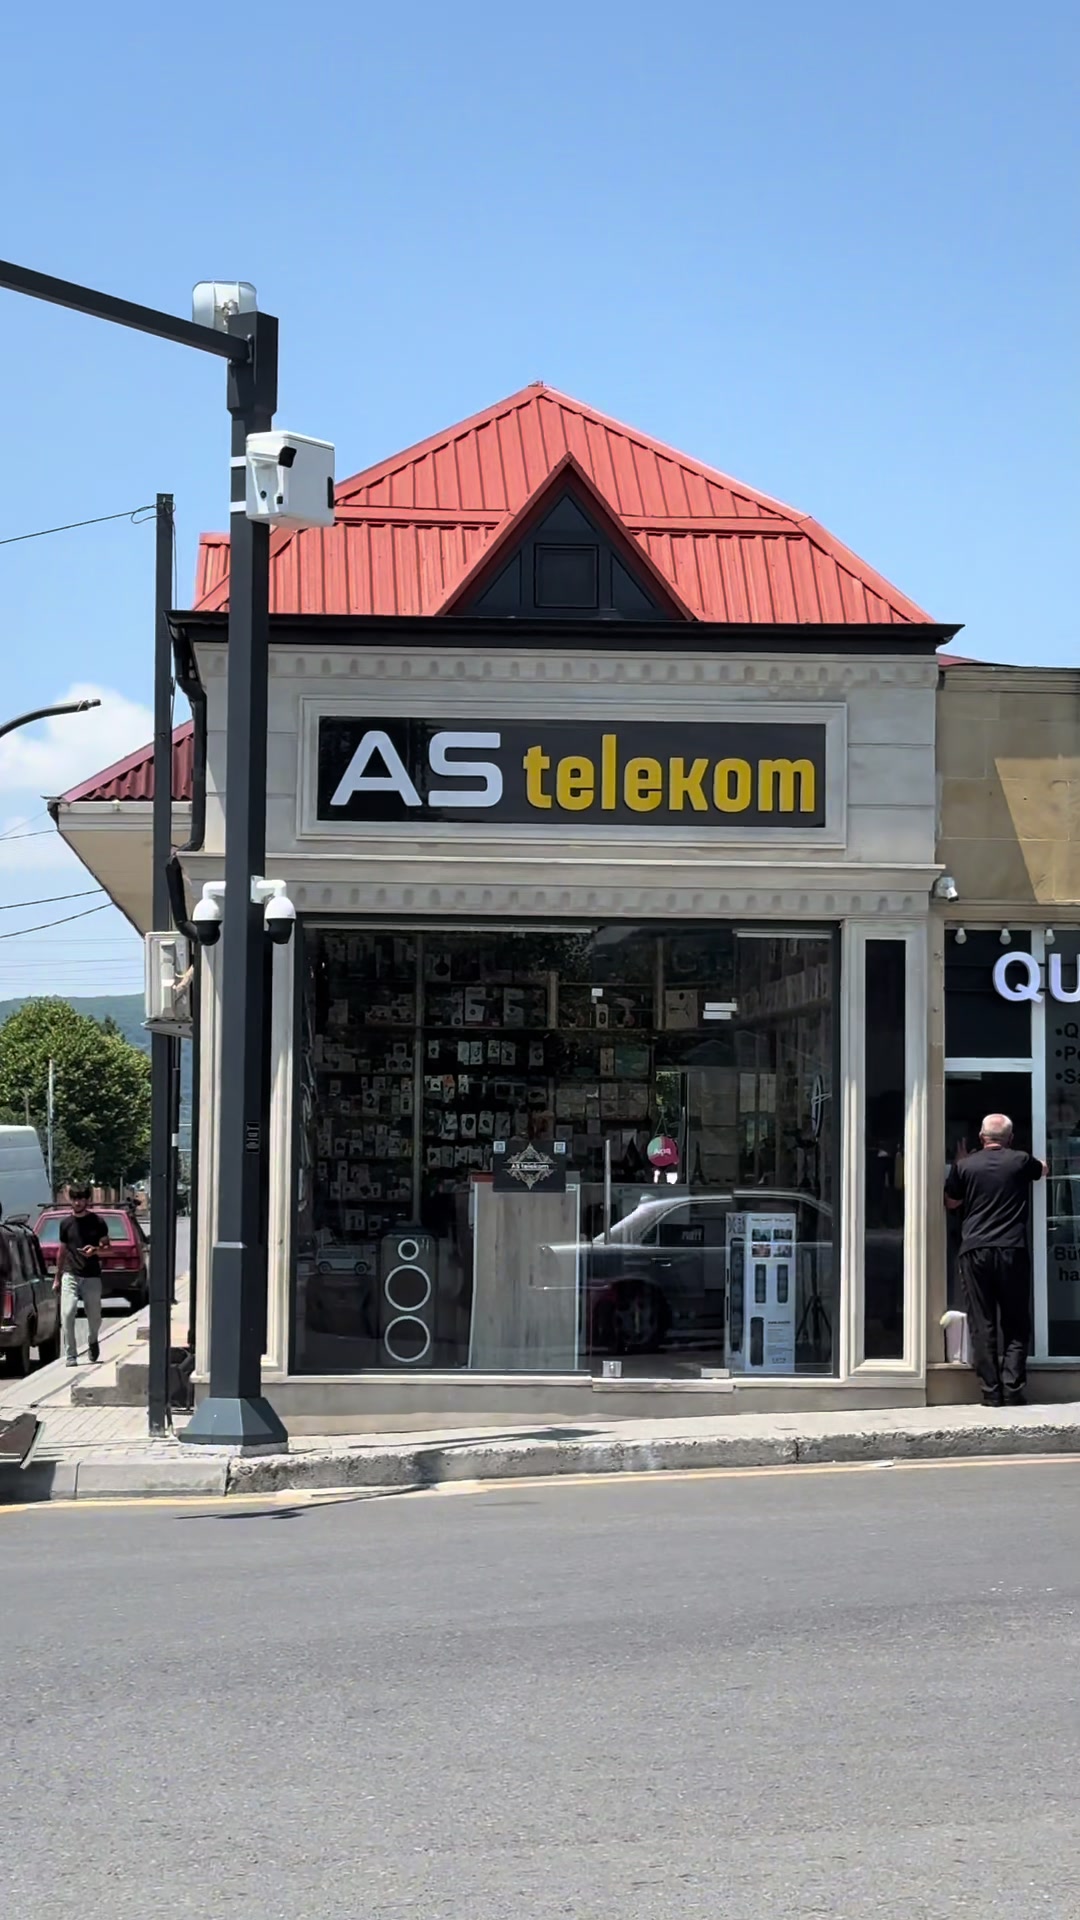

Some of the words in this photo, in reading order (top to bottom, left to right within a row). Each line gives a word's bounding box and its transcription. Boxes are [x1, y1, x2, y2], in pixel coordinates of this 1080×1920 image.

[330, 730, 503, 807] AS
[523, 734, 815, 812] telekom
[1054, 1245, 1080, 1261] Bü
